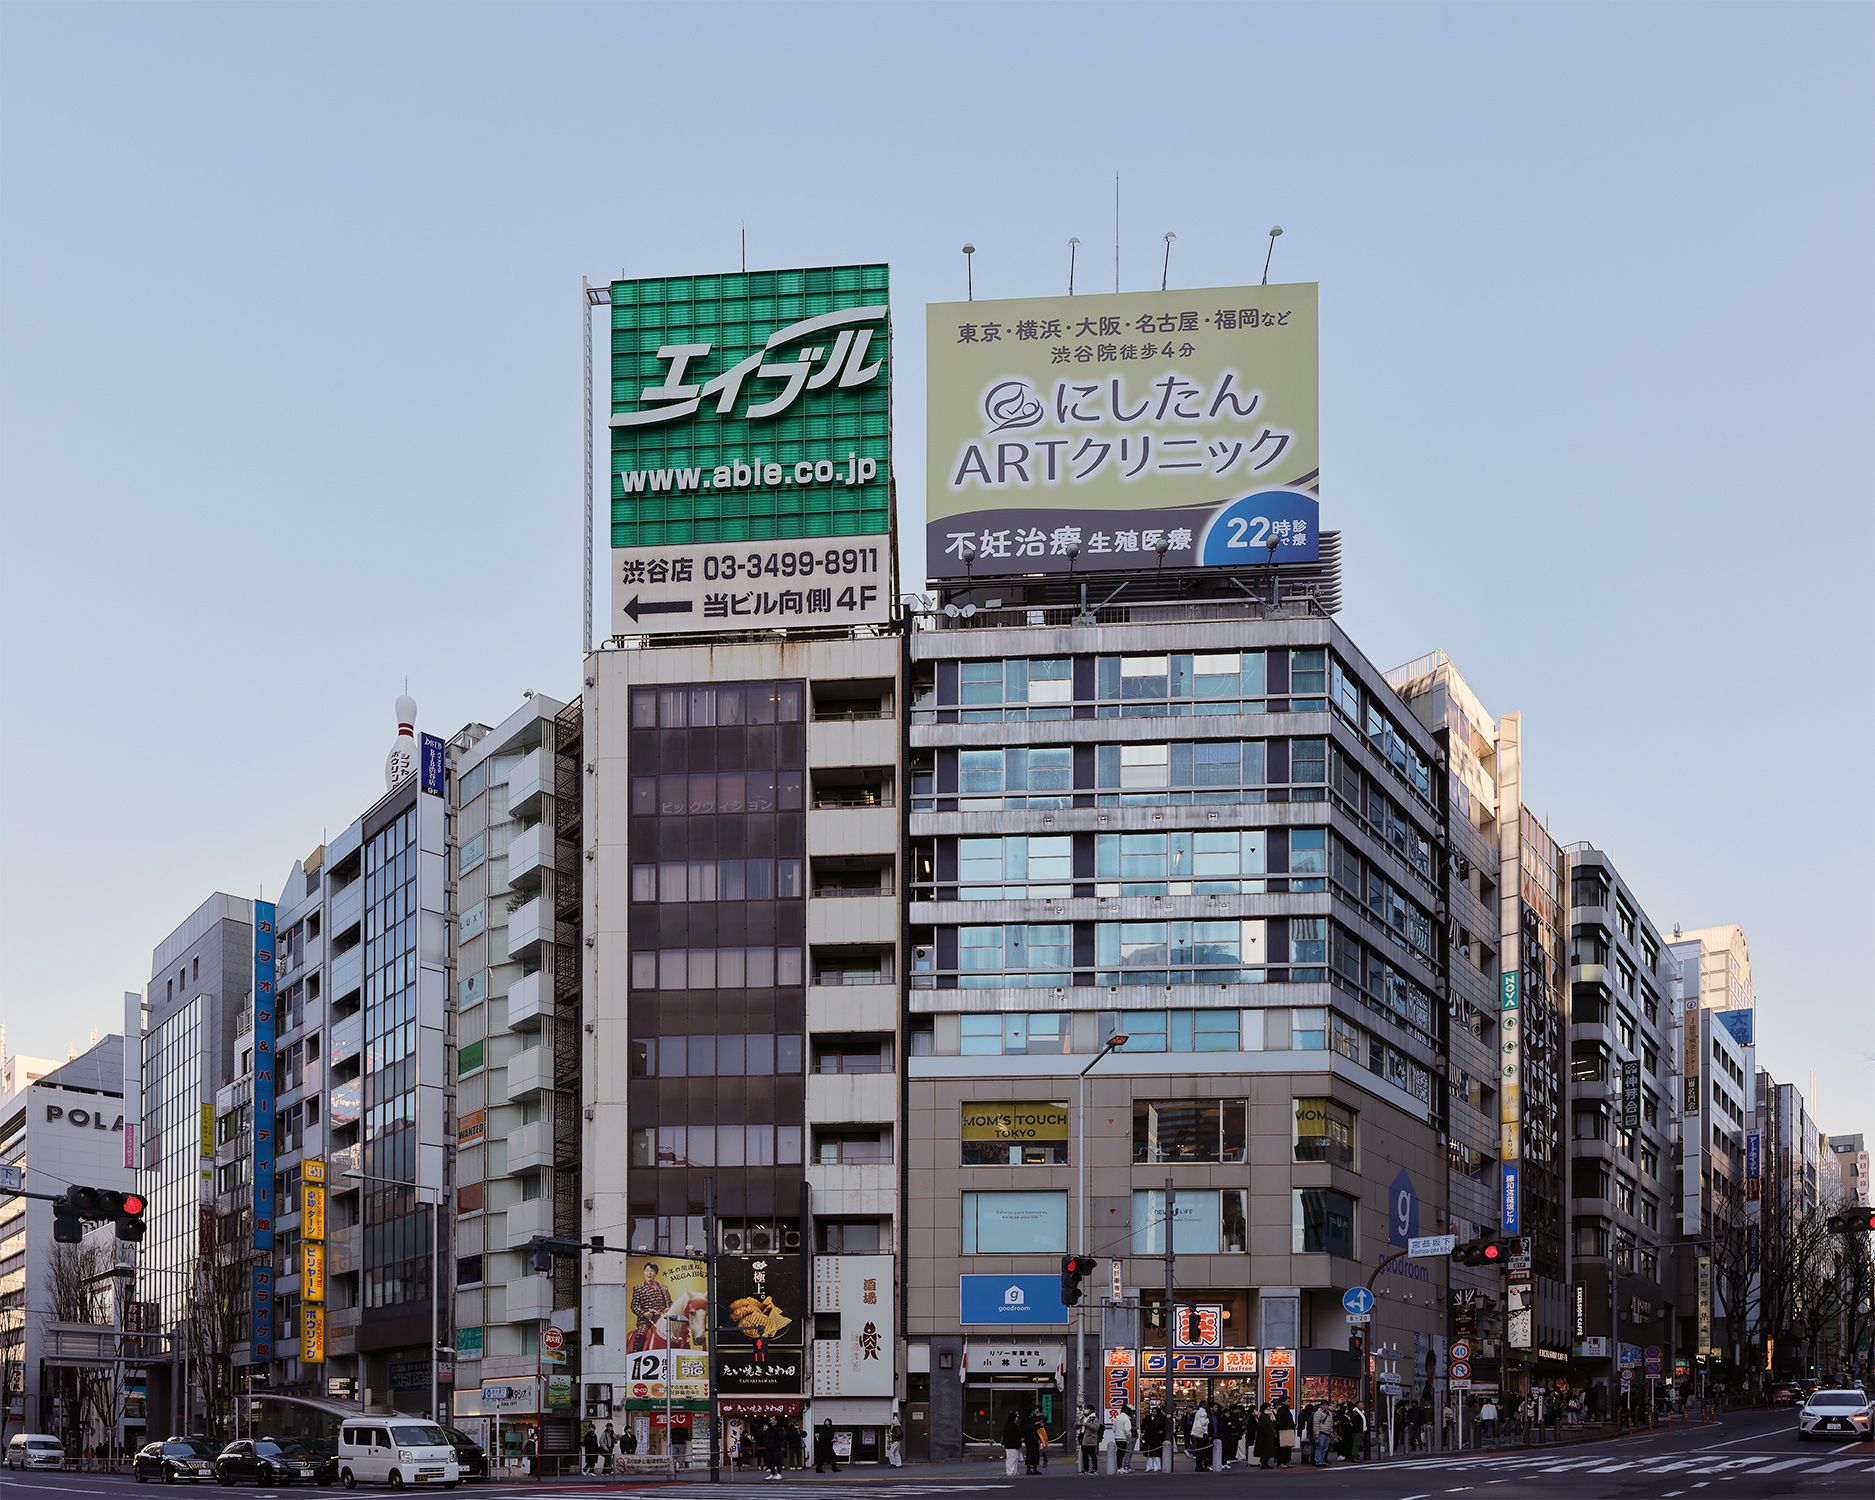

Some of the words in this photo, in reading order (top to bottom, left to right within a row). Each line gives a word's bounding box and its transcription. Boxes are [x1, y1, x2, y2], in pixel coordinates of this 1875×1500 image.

[1051, 340, 1196, 365] 渋谷院徒歩4分
[608, 305, 888, 427] エイブル
[1057, 374, 1259, 423] にしたん
[954, 429, 1290, 486] ARTクリニック
[621, 452, 877, 493] www.able.co.jp
[945, 526, 1082, 560] 不妊治療
[622, 557, 693, 585] 渋谷店
[703, 548, 878, 581] 03-3499-8911
[459, 909, 484, 930] LUXY
[1505, 974, 1516, 1008] NOVA
[1625, 1074, 1639, 1113] 伸芽会
[458, 1123, 484, 1141] WANTED
[963, 1114, 1012, 1127] MOM'S
[1015, 1114, 1067, 1125] TOUCH
[995, 1129, 1036, 1138] TOKYO
[306, 1248, 317, 1297] ビリヤード
[256, 1272, 270, 1356] カラオケ館
[998, 1304, 1031, 1313] goodroom
[306, 1309, 317, 1358] ボウリング
[983, 1358, 1046, 1367] 小林ビル
[1109, 1350, 1131, 1366] 薬
[1148, 1354, 1221, 1370] ダイコク
[1226, 1352, 1255, 1366] 免税
[1269, 1350, 1292, 1366] 薬
[1454, 1347, 1466, 1356] 40
[631, 1355, 660, 1380] 12
[1110, 1368, 1130, 1408] ダイコク
[656, 1414, 686, 1424] 宝くじ
